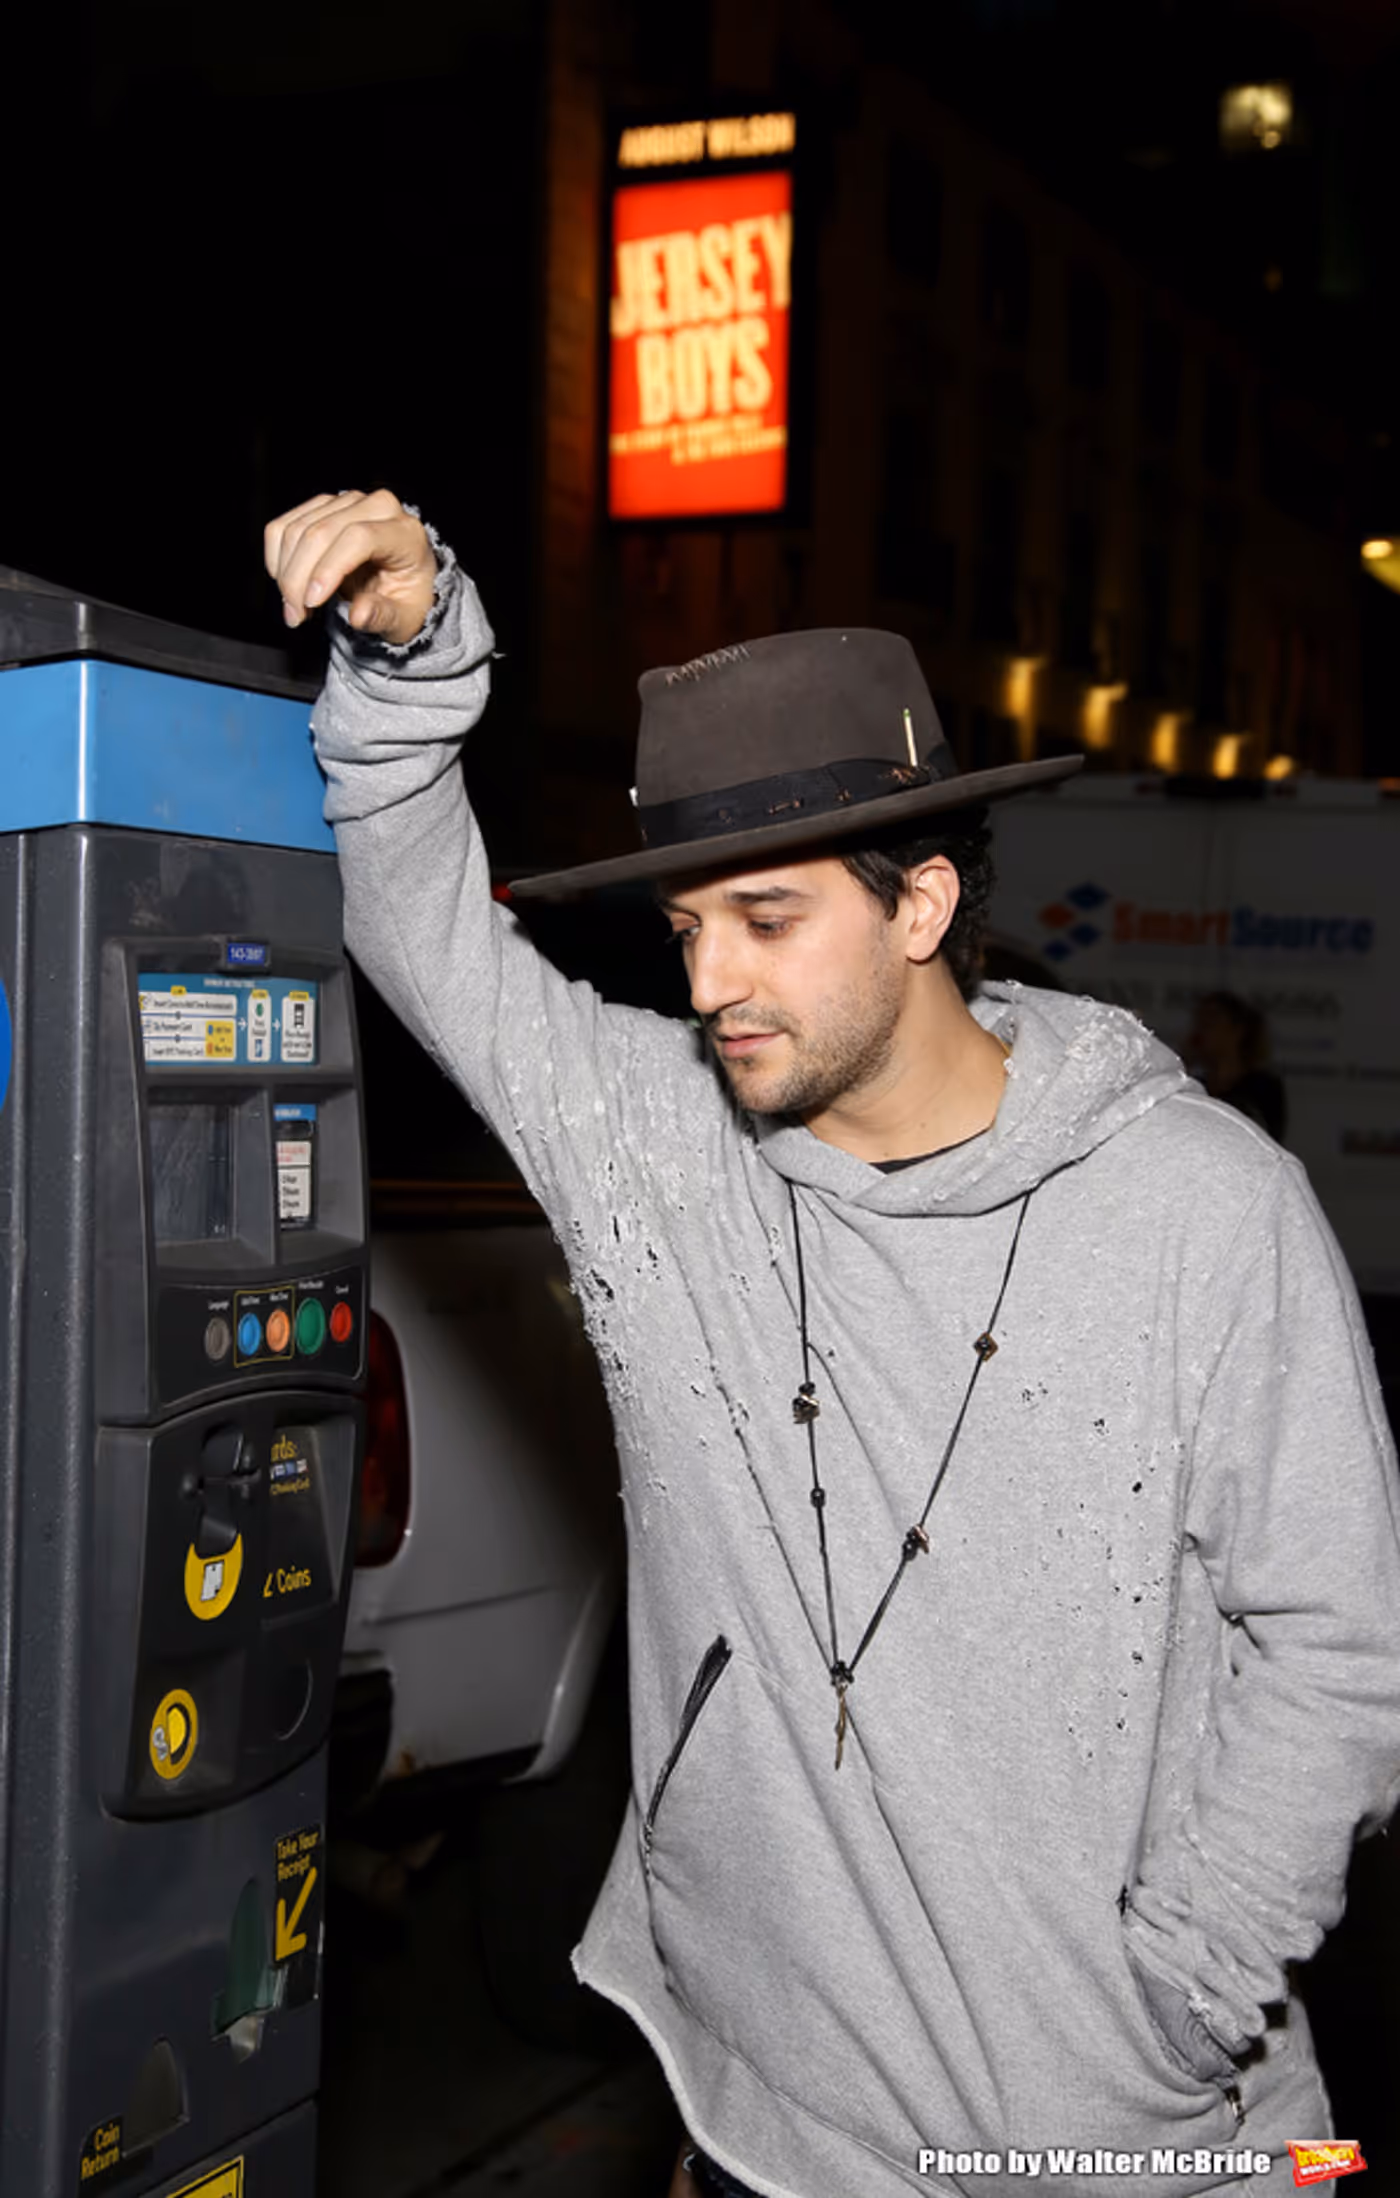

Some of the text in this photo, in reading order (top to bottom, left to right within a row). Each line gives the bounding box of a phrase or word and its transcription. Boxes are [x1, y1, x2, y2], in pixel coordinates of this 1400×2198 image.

[618, 121, 704, 168] AUGUST
[610, 211, 791, 338] JERSEY
[636, 317, 772, 426] BOYS
[276, 1566, 312, 1594] Coins
[277, 1831, 319, 1860] Take Your
[277, 1854, 310, 1882] Receipt
[93, 2122, 120, 2151] Coin
[81, 2146, 120, 2180] Return
